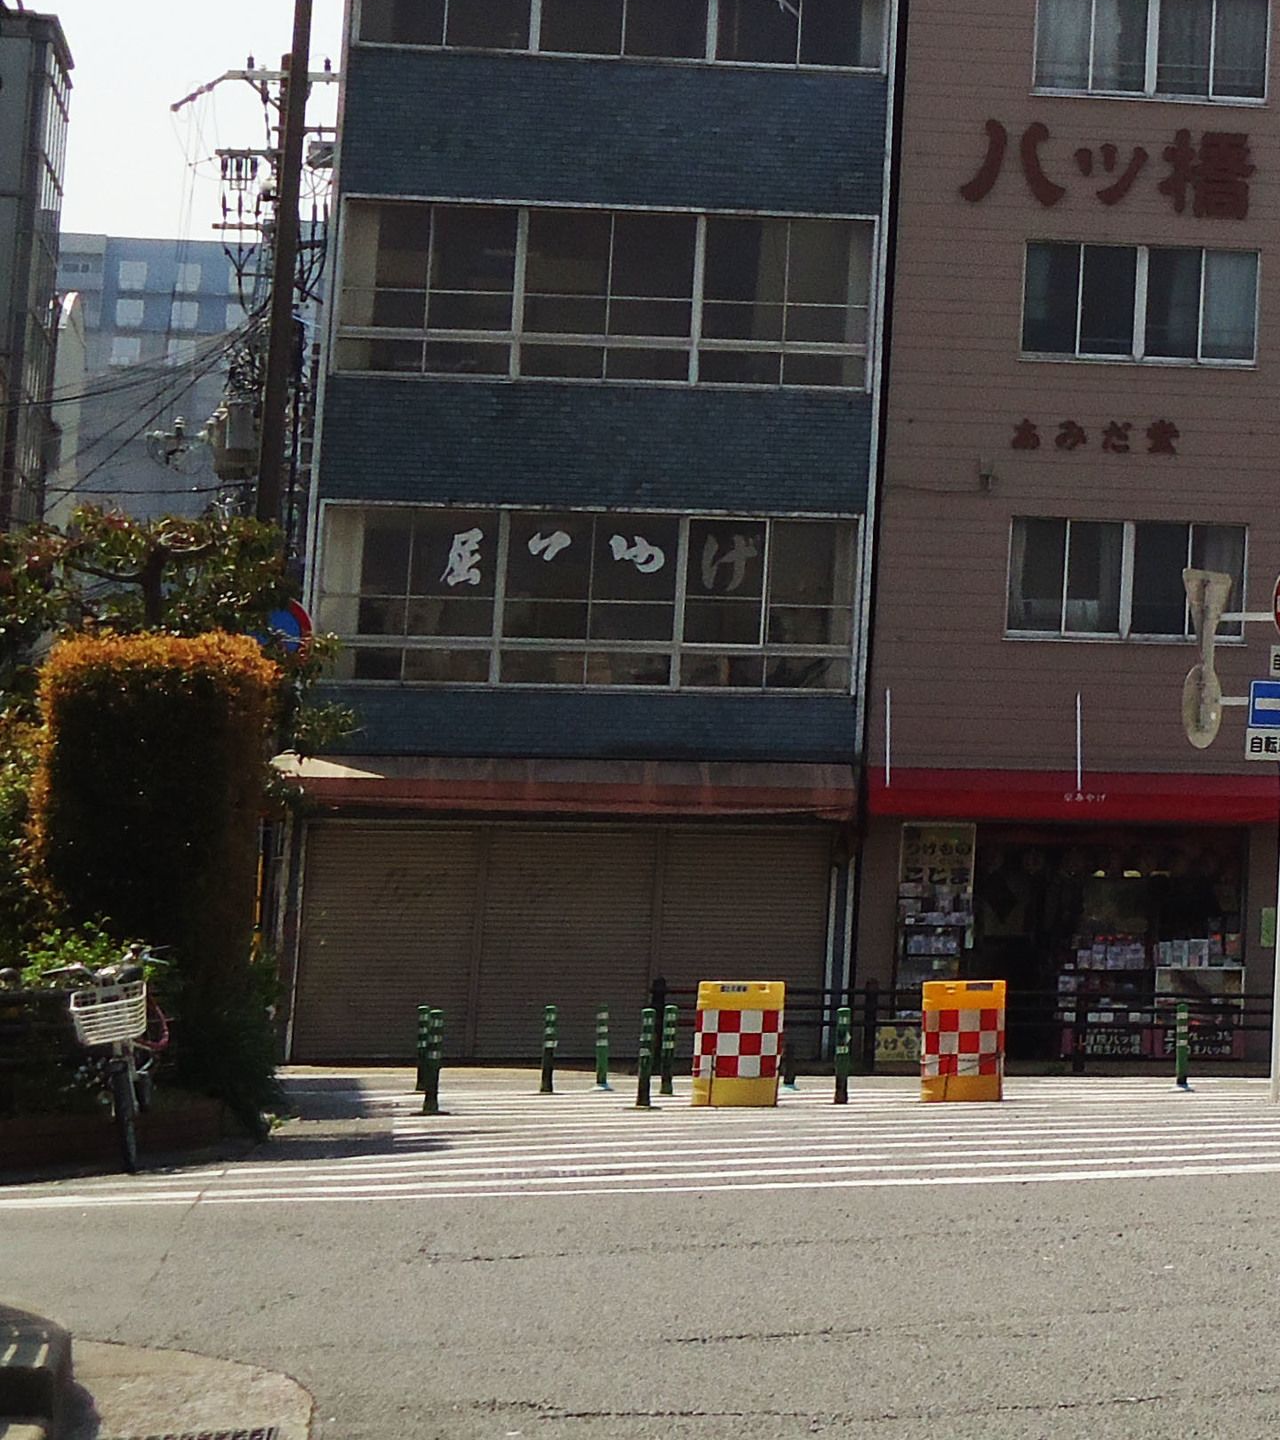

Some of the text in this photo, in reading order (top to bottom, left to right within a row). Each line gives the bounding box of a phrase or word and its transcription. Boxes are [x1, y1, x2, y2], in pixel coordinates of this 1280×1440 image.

[958, 117, 1257, 220] 八ツ橋
[1011, 417, 1182, 456] あみだ堂
